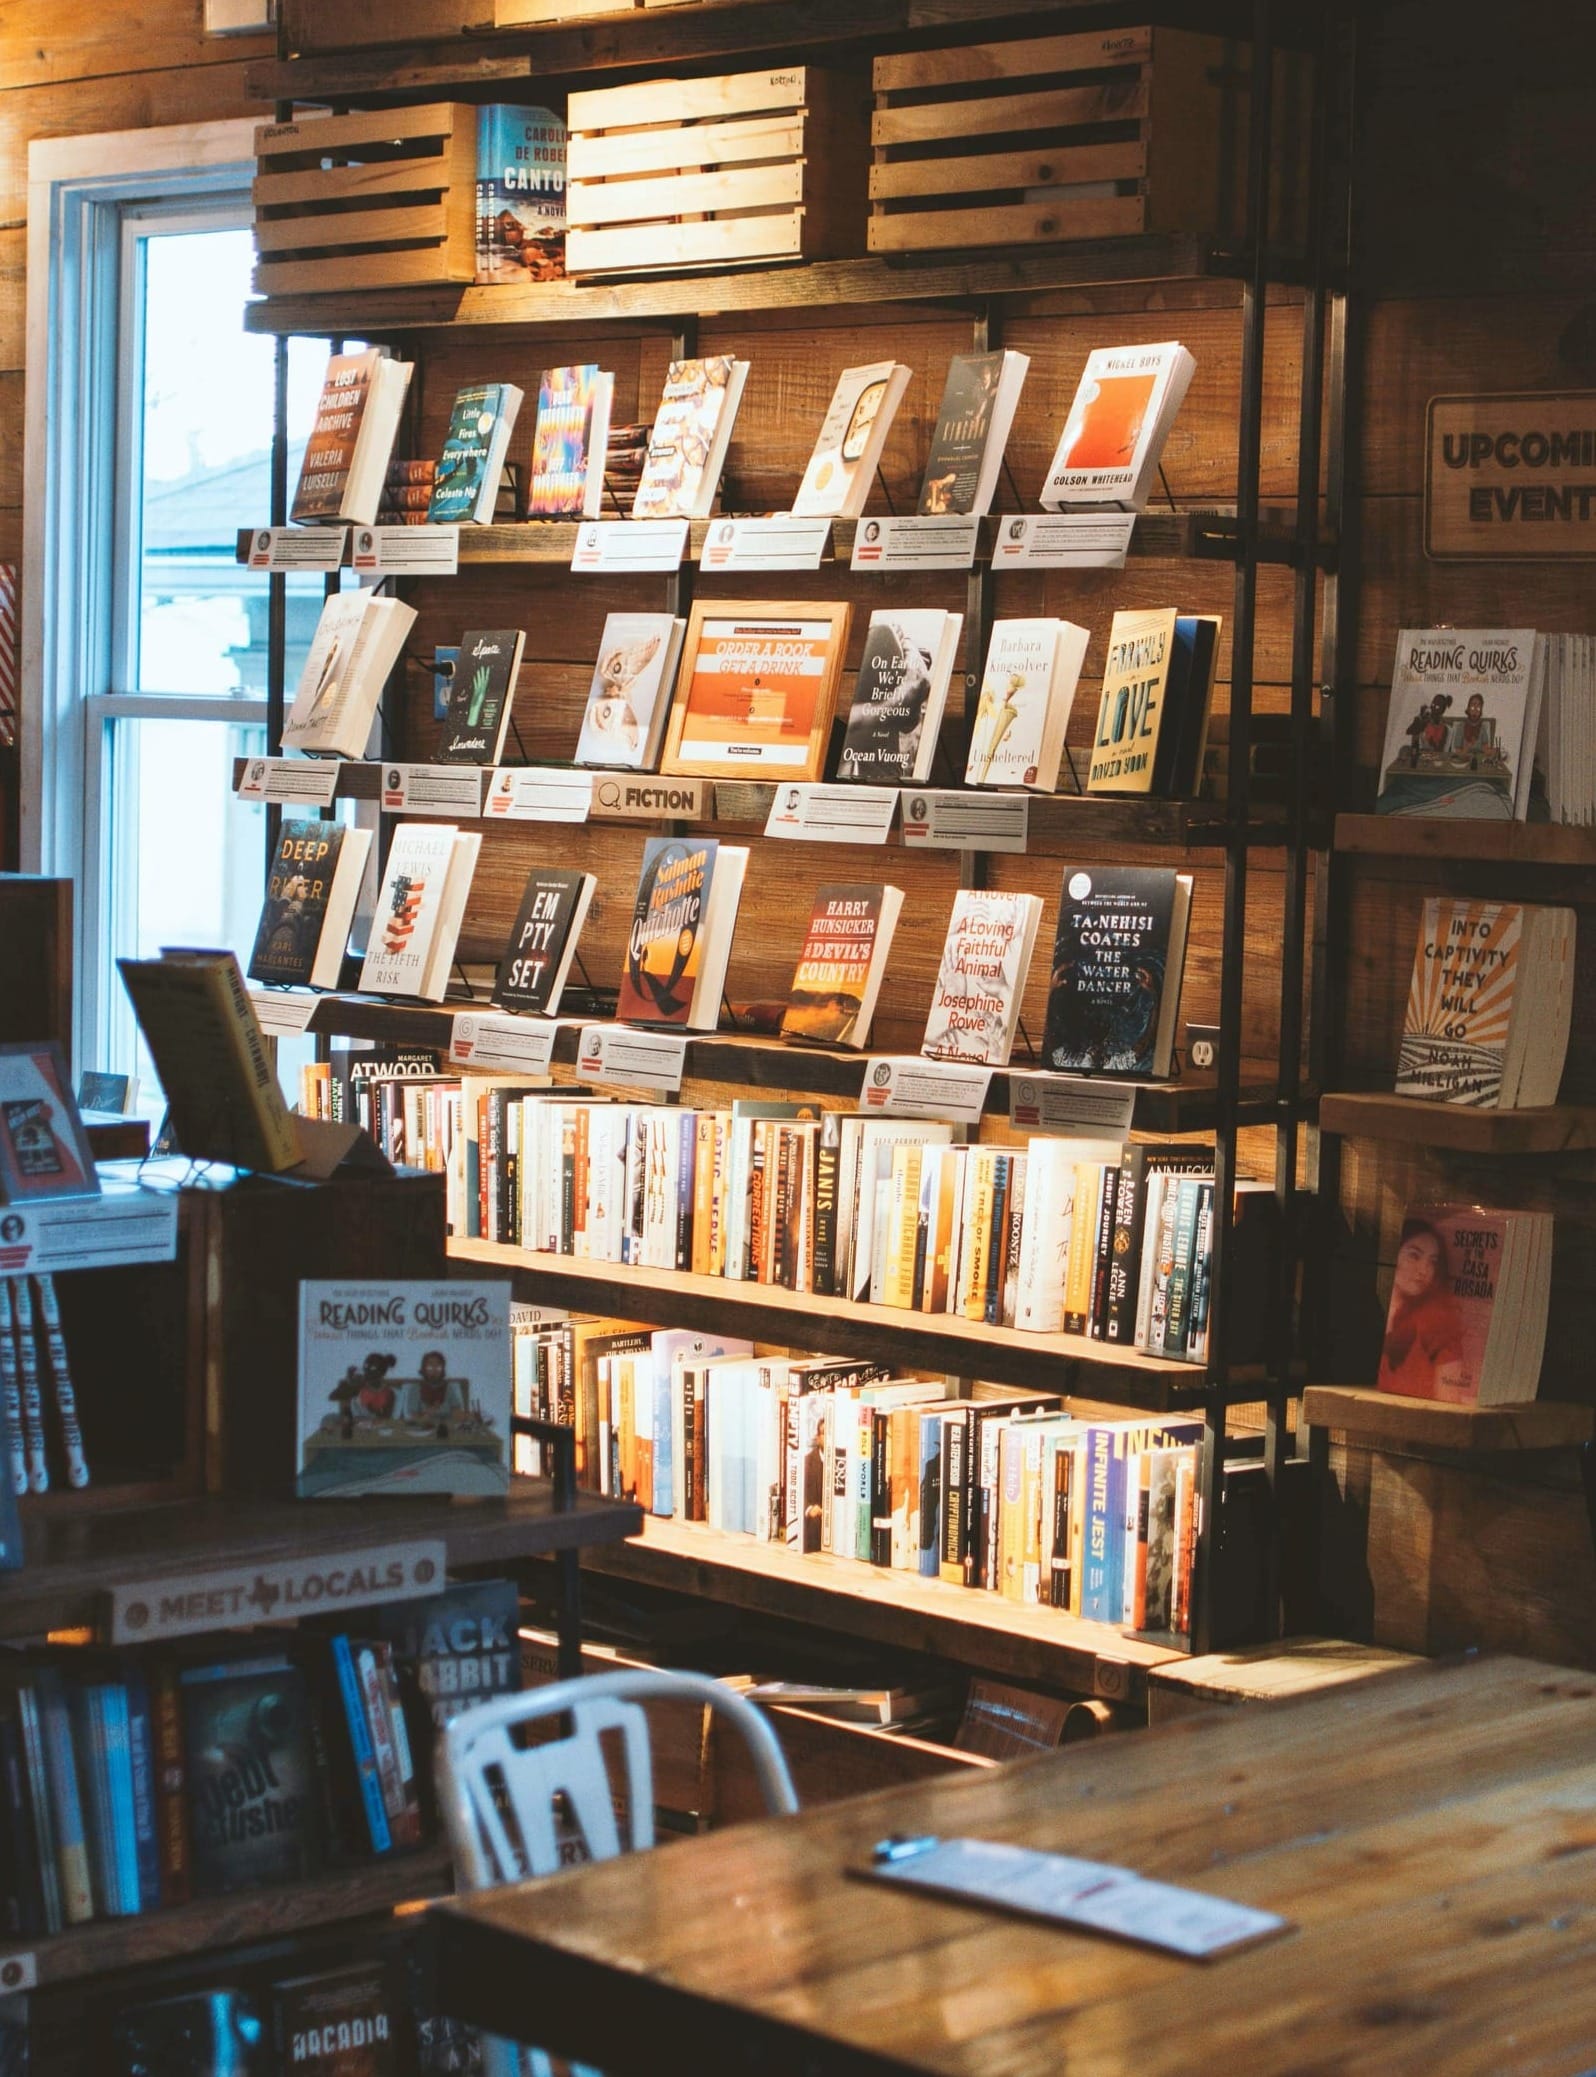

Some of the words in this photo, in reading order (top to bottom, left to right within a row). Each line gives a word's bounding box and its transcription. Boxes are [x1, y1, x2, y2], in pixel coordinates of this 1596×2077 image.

[515, 145, 529, 161] DE
[533, 147, 568, 163] ROBE
[503, 166, 570, 192] CANTO
[1106, 356, 1135, 370] NICKEL
[1138, 355, 1161, 368] BOYS
[334, 367, 357, 387] LOST
[319, 390, 361, 411] CHILDREN
[317, 412, 354, 434] ARCHIVE
[462, 408, 481, 421] Little
[458, 427, 477, 440] Fires
[310, 449, 343, 468] VALERIA
[442, 446, 488, 461] Everywhere
[1443, 430, 1596, 470] UPCOMI
[303, 472, 340, 491] LUISELLI
[1053, 474, 1088, 486] COLSON
[1091, 473, 1133, 485] WHITEHEAD
[435, 488, 460, 501] Celeste
[462, 487, 477, 500] Ng
[1469, 486, 1596, 522] EVENT
[715, 641, 759, 657] ORDER
[759, 641, 771, 657] A
[773, 641, 815, 658] BOOK
[1410, 644, 1466, 673] READING
[1469, 646, 1518, 674] QUIRKS
[718, 659, 745, 675] GET
[748, 660, 759, 675] A
[761, 660, 804, 676] DRINK
[871, 656, 888, 670] On
[989, 657, 1049, 674] Kingsolver
[878, 671, 906, 686] We're
[871, 687, 906, 703] Briefly
[861, 704, 911, 722] Gorgeous
[1097, 677, 1160, 748] LOVE
[843, 748, 875, 763] Ocean
[877, 748, 911, 767] Vuong
[1091, 759, 1122, 782] DAVID
[1122, 751, 1149, 775] YOON
[625, 787, 695, 811] FICTION
[281, 839, 329, 862] DEEP
[657, 849, 708, 883] Salman
[269, 876, 324, 900] RIVER
[651, 868, 705, 913] Rushdie
[530, 891, 561, 921] EM
[826, 901, 869, 917] HARRY
[630, 895, 701, 961] Quichotte
[811, 919, 875, 935] HUNSICKER
[957, 917, 969, 933] A
[969, 919, 1015, 943] Loving,
[1072, 914, 1154, 931] TA-NEHISI
[1451, 919, 1491, 938] INTO
[518, 922, 556, 951] PTY
[956, 937, 1009, 957] Faithful
[1079, 931, 1141, 947] COATES
[367, 950, 388, 966] THE
[388, 951, 420, 967] FIFTH
[812, 941, 871, 961] DEVIL'S
[1095, 950, 1122, 963] THE
[1424, 943, 1510, 967] CAPTIVITY
[375, 969, 401, 985] RISK
[508, 958, 544, 990] SET
[799, 962, 867, 984] COUNTRY
[954, 957, 1002, 978] Animal
[1082, 964, 1130, 978] WATER
[1442, 969, 1487, 989] THEY
[1077, 980, 1131, 993] DANCER
[938, 991, 1004, 1015] Josephine
[1440, 994, 1478, 1014] WILL
[948, 1010, 986, 1032] Rowe
[1444, 1023, 1467, 1039] GO
[1428, 1050, 1473, 1070] NOAH
[350, 1062, 436, 1082] ATWOOD
[1411, 1069, 1483, 1093] MILLIGAN
[713, 1125, 723, 1179] OPTIC
[816, 1150, 836, 1211] JANIS
[1145, 1165, 1177, 1182] ANN
[1104, 1172, 1114, 1205] NIGHT
[1115, 1179, 1126, 1225] TOWER
[1123, 1181, 1136, 1226] RAVEN
[1181, 1188, 1194, 1226] DENNIS
[710, 1196, 719, 1254] NERVE
[751, 1170, 765, 1265] CORRECTIONS
[902, 1214, 917, 1264] RICHARD
[1009, 1213, 1023, 1265] KOONTZ
[1100, 1208, 1110, 1256] JOURNEY
[1453, 1230, 1498, 1249] SECRETS
[1160, 1231, 1173, 1265] JUSTICE
[1176, 1231, 1190, 1271] LEHANE
[804, 1251, 812, 1270] GAY
[1462, 1259, 1490, 1280] CASA
[899, 1267, 913, 1296] FORD
[971, 1247, 982, 1301] SMOKE
[1109, 1261, 1119, 1302] LECKIE
[1116, 1268, 1127, 1299] ANN
[1453, 1278, 1494, 1299] ROSADA
[319, 1297, 406, 1331] READING
[414, 1297, 490, 1329] QUIRKS
[509, 1309, 542, 1325] DAVID
[562, 1351, 571, 1387] SHAFAK
[788, 1400, 799, 1449] EMPTY
[861, 1407, 869, 1425] THE
[951, 1425, 961, 1443] NEAL
[834, 1456, 846, 1491] 1984
[950, 1443, 960, 1487] STEPHENSON
[1093, 1432, 1109, 1513] INFINITE
[1006, 1467, 1017, 1498] Help
[788, 1488, 796, 1516] SCOTT
[947, 1491, 960, 1562] CRYPTONOMICON
[1091, 1516, 1106, 1561] JEST
[159, 1586, 245, 1624] MEET
[284, 1562, 404, 1601] LOCALS
[406, 1616, 510, 1654] ACK
[405, 1651, 512, 1695] ABBIT
[293, 2013, 390, 2063] ARCADIA
